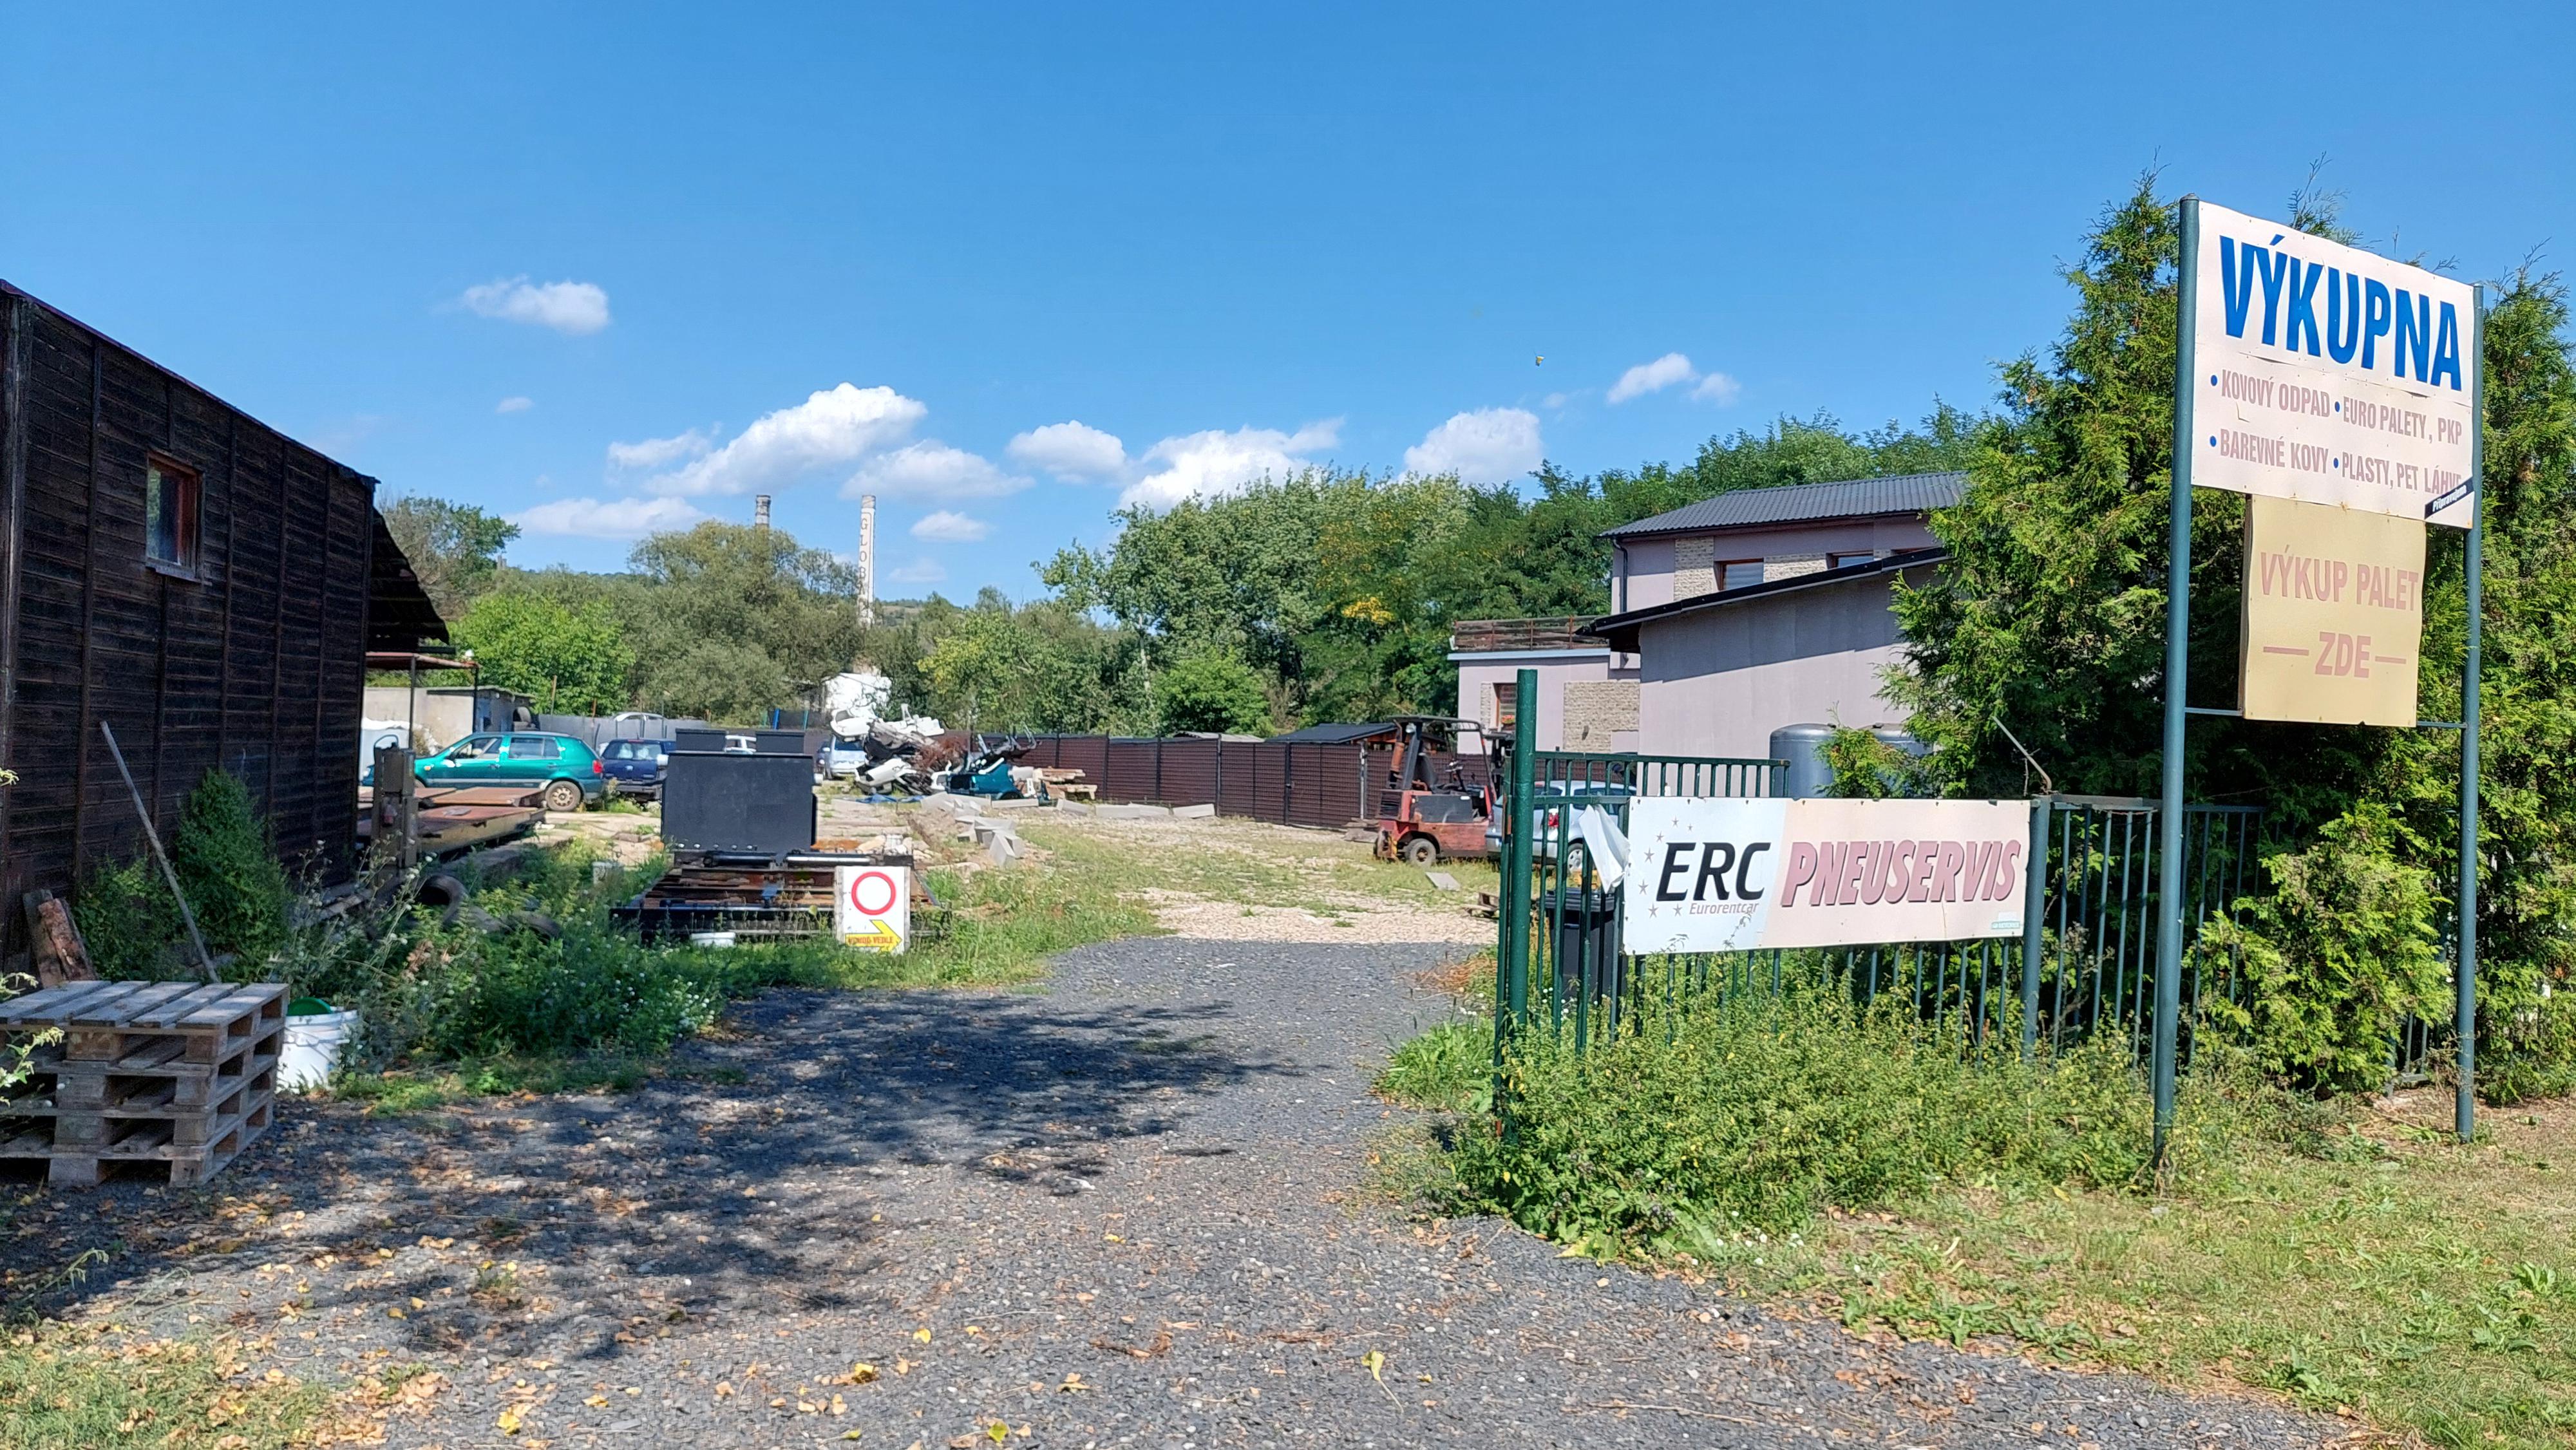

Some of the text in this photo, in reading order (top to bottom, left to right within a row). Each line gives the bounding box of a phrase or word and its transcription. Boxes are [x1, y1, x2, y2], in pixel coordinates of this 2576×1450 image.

[2219, 234, 2462, 391] VÝKUPNA
[2221, 369, 2330, 417] KOVOVÝ ODPAD
[2343, 396, 2376, 429] EURO
[2438, 417, 2462, 445] PKP
[2220, 428, 2329, 474] BAREVNÉ KOVY
[2342, 451, 2393, 489] PLASTY,
[2396, 462, 2419, 491] PET
[2260, 544, 2419, 611] VÝKUP PALET
[2315, 631, 2371, 678] ZDE
[1656, 842, 1772, 901] ERC
[1780, 839, 2022, 908] PNEUSERVIS
[1689, 903, 1759, 915] Eurorentcar
